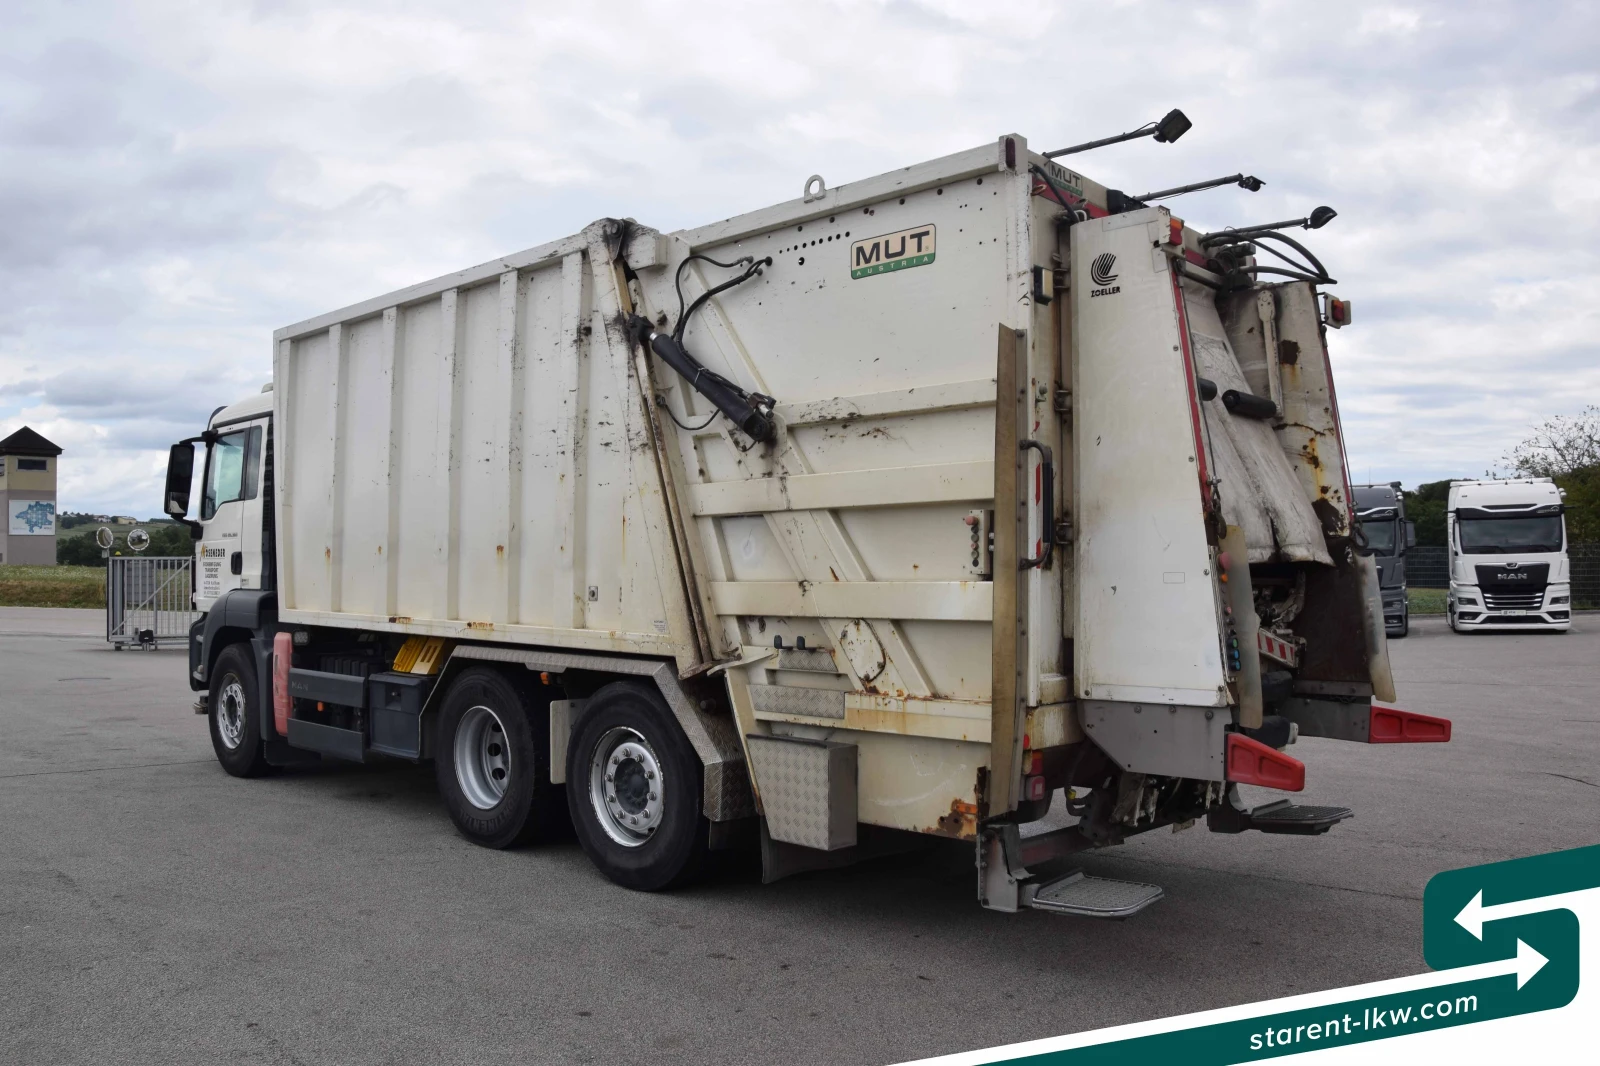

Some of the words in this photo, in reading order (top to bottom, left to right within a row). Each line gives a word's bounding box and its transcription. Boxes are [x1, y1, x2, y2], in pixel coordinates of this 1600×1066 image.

[1051, 165, 1080, 187] MUT
[855, 230, 930, 267] MUT
[857, 256, 928, 276] AUSTRIA
[1091, 286, 1120, 297] ZOELLER
[291, 680, 309, 692] MAN
